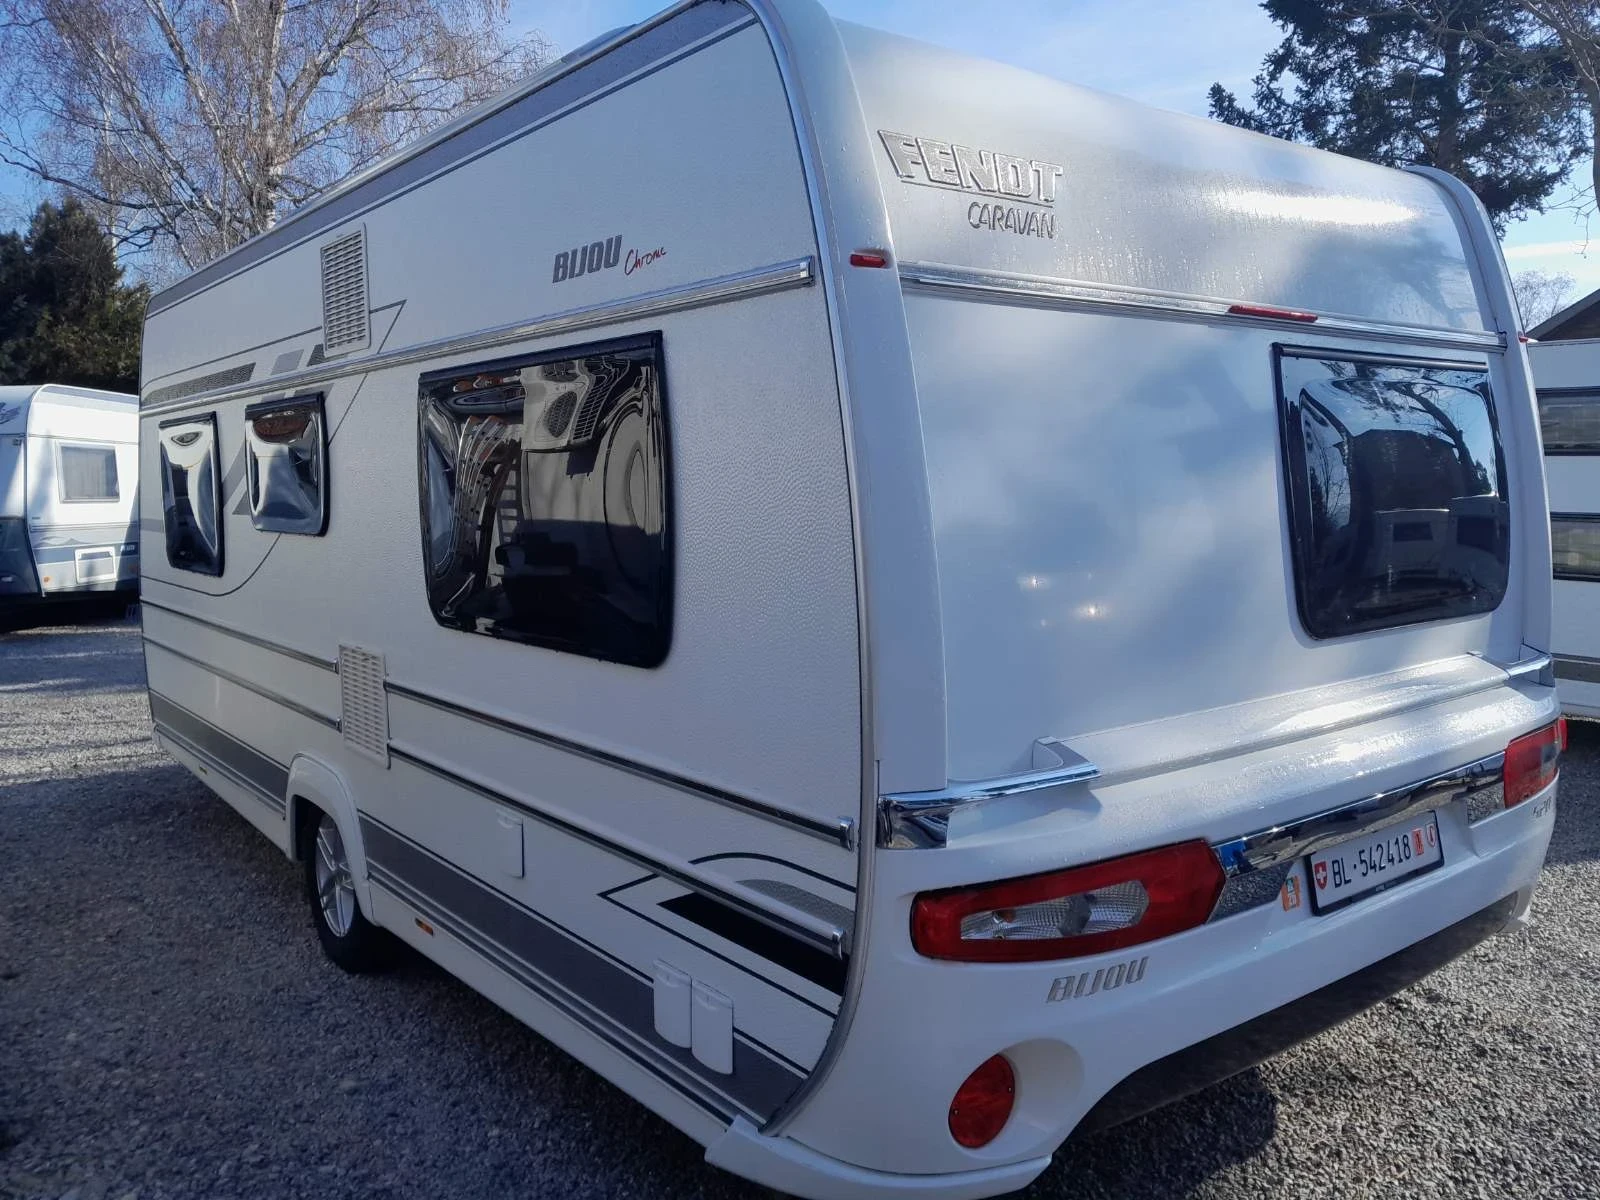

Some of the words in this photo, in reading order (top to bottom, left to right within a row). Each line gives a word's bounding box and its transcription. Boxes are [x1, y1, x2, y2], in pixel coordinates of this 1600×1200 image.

[877, 130, 1063, 202] FENDT
[967, 202, 1056, 239] CARAVAN
[552, 234, 622, 284] BIJOU
[1046, 956, 1149, 1003] BIJOU
